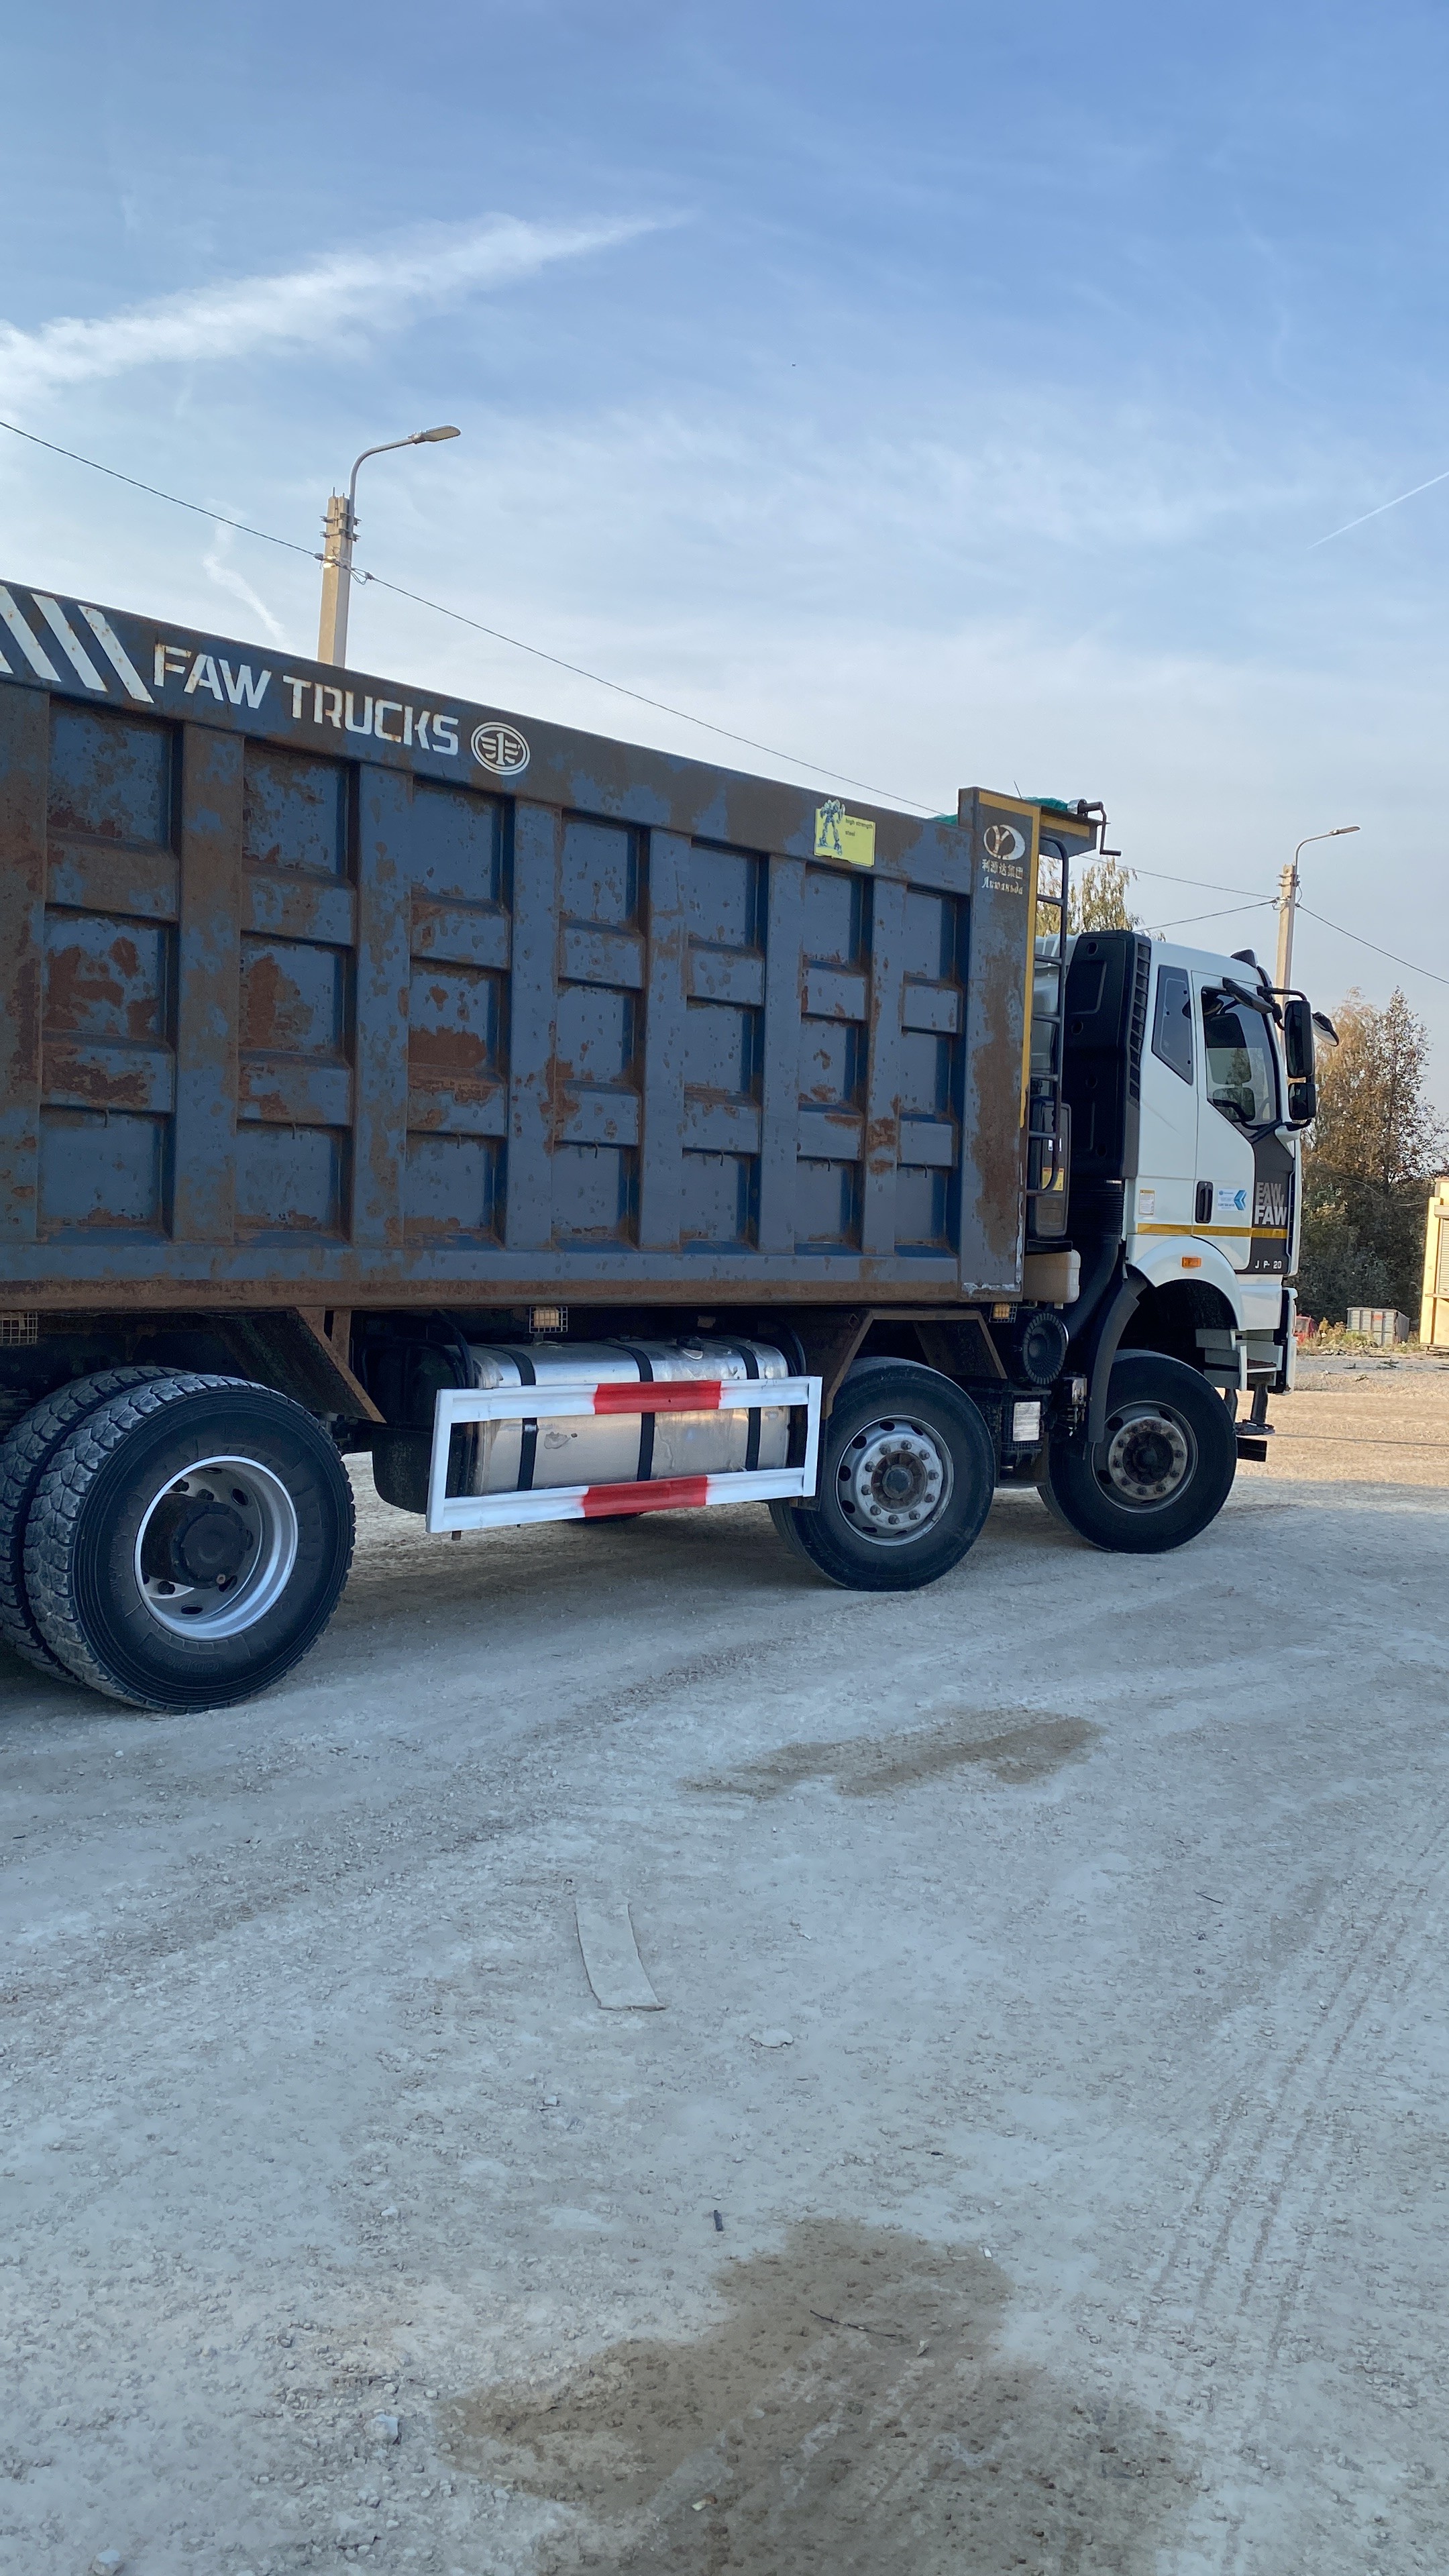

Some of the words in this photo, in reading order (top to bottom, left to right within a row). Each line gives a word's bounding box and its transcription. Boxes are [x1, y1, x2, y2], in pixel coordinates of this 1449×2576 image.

[154, 643, 272, 710] FAW
[282, 675, 460, 755] TRUCKS
[1254, 1205, 1287, 1226] FAW
